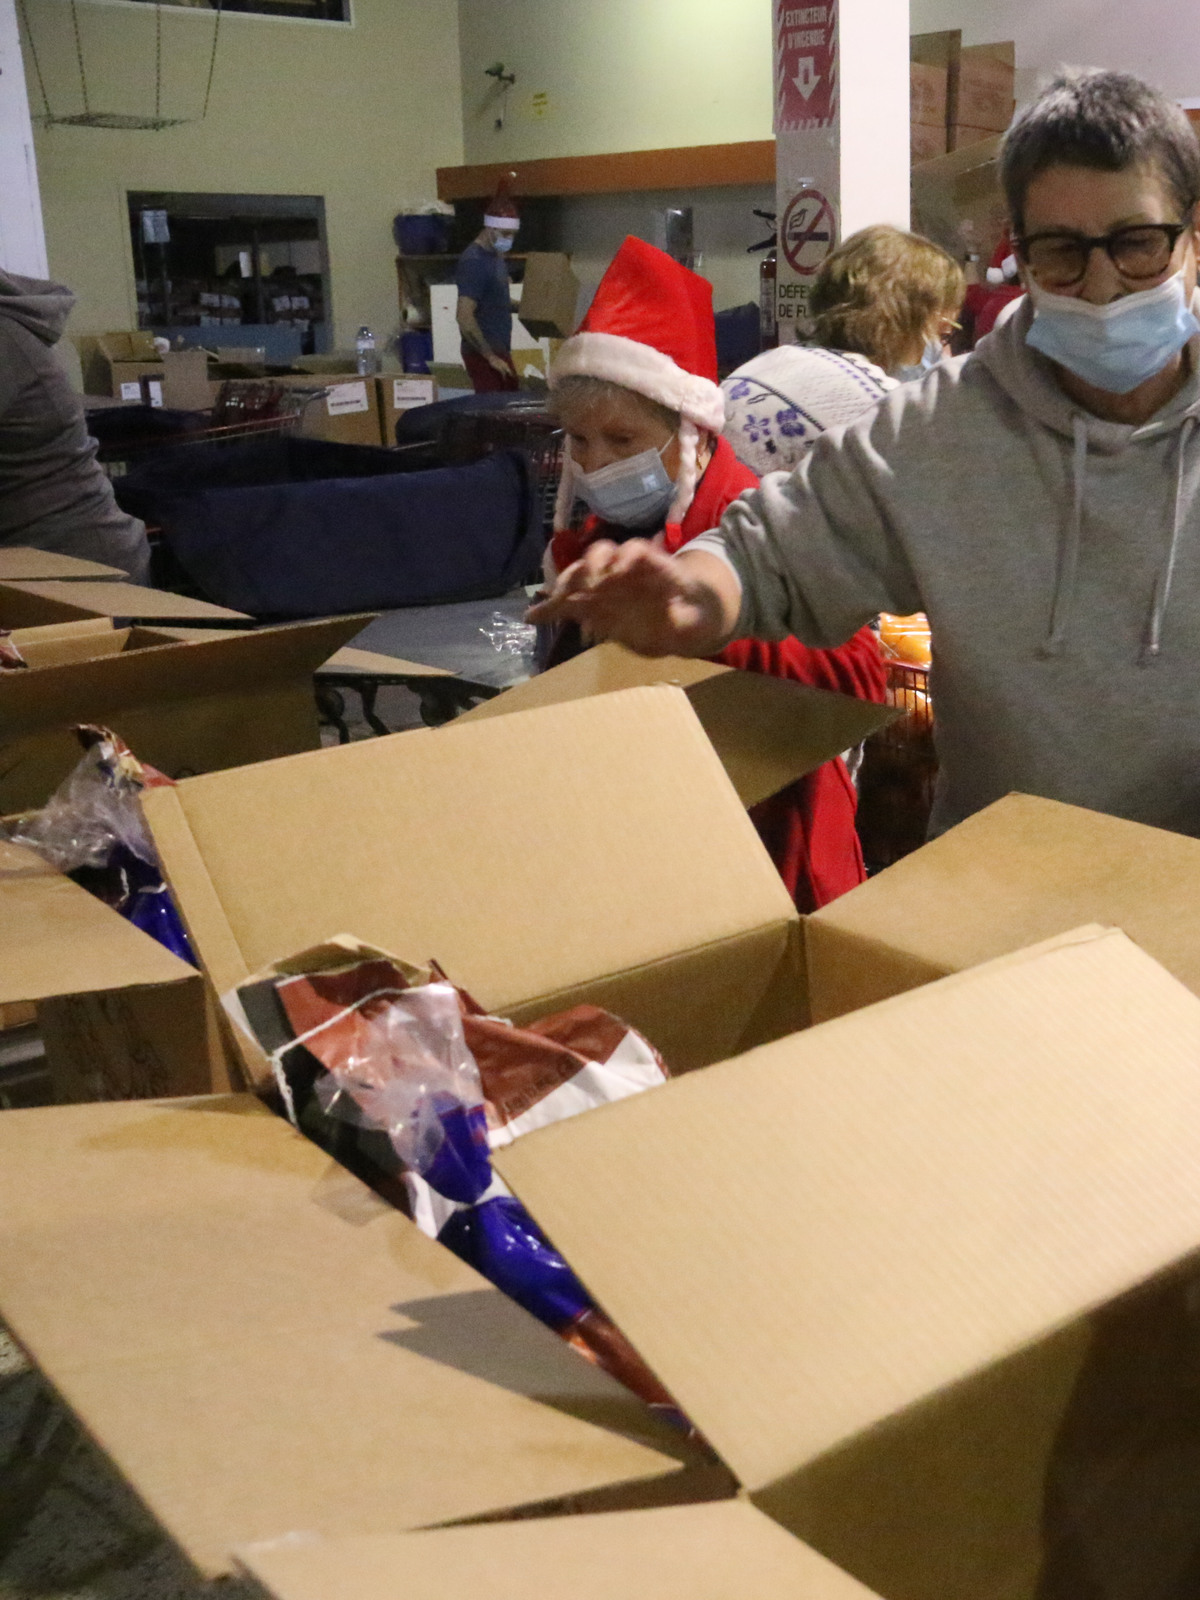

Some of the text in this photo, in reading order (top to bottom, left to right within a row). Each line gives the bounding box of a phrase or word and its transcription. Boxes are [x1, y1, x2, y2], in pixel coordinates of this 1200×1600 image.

[785, 6, 828, 27] EXTINCTEUR
[779, 282, 809, 298] DÉFE
[778, 304, 793, 318] DE
